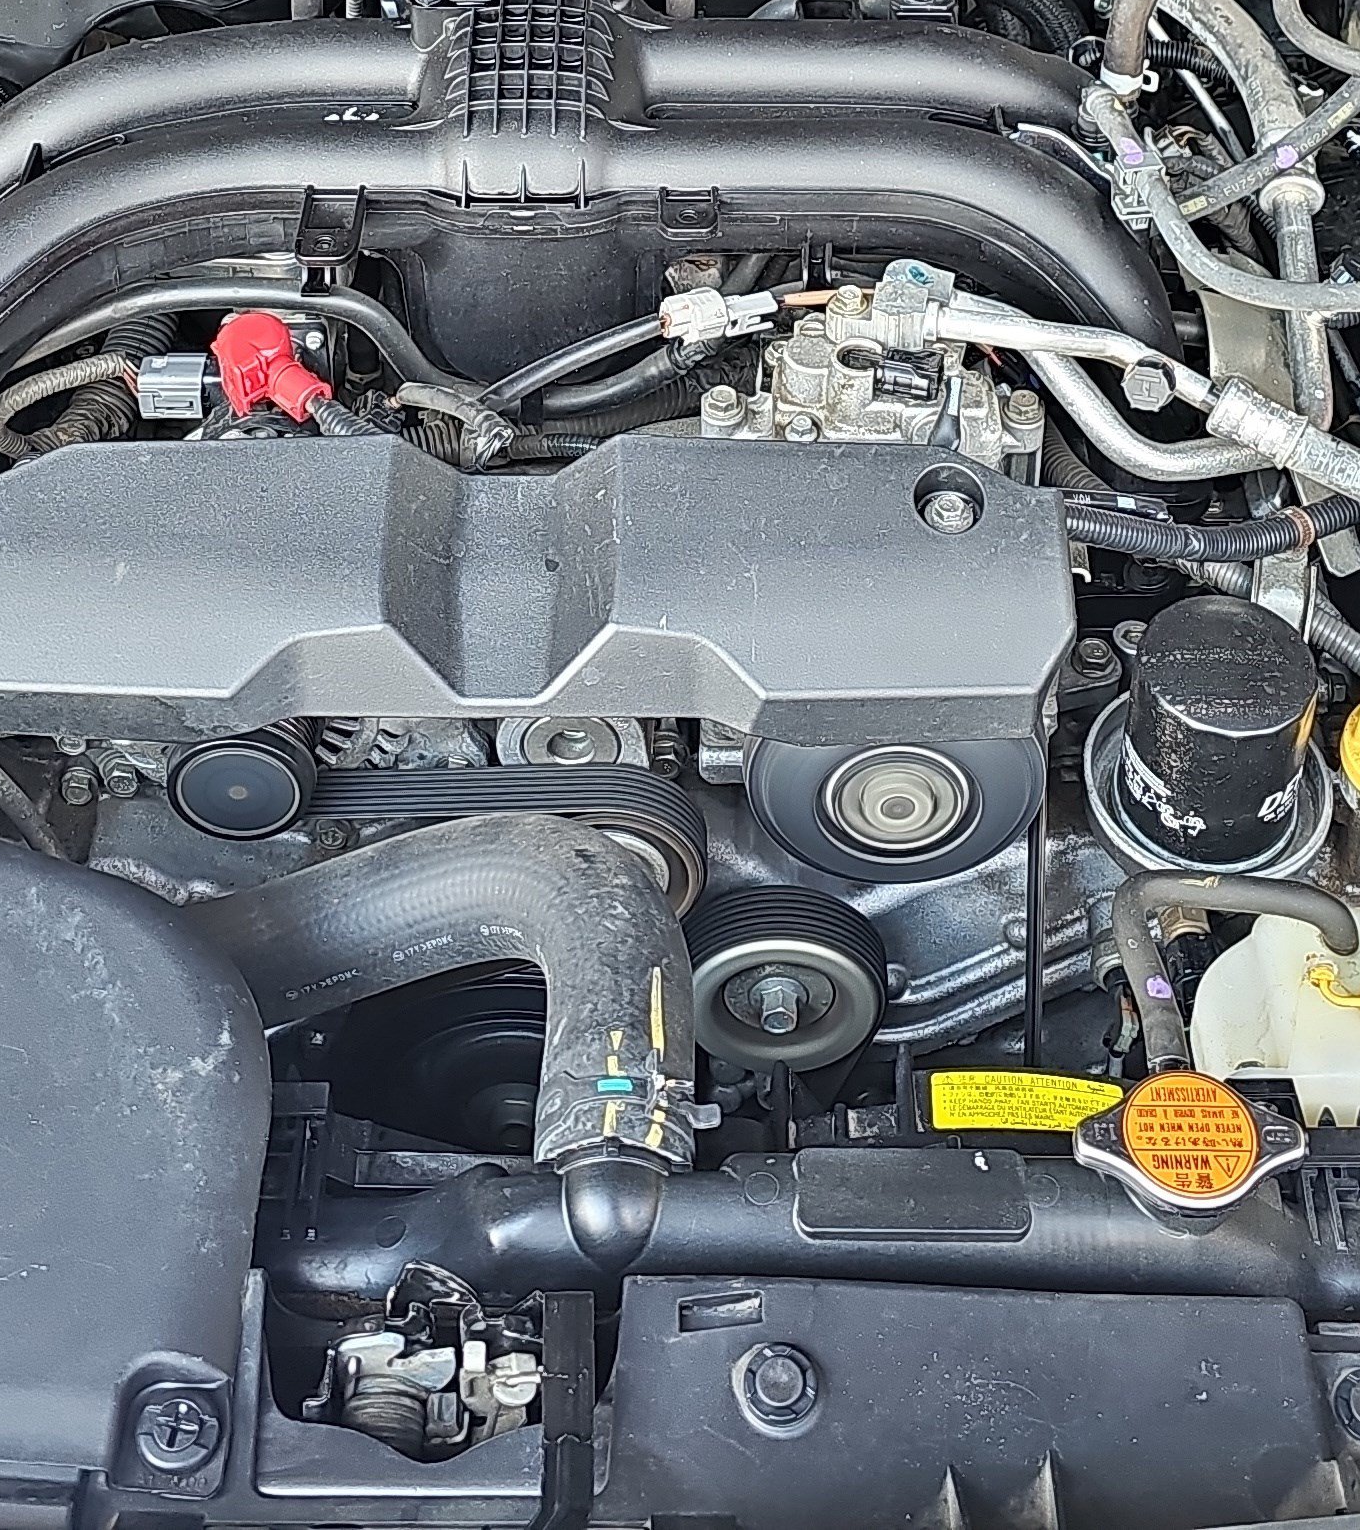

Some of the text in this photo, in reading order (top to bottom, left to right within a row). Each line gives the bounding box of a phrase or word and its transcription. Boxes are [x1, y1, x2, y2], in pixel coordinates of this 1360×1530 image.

[984, 1074, 1024, 1085] CAUTION
[1030, 1076, 1078, 1090] ATTENTION
[1150, 1087, 1217, 1102] AVERTISSMENT
[1134, 1122, 1243, 1133] NEVER OPEN WHEN HOT.
[1151, 1154, 1212, 1171] WARNING
[1173, 1172, 1215, 1189] 警告
